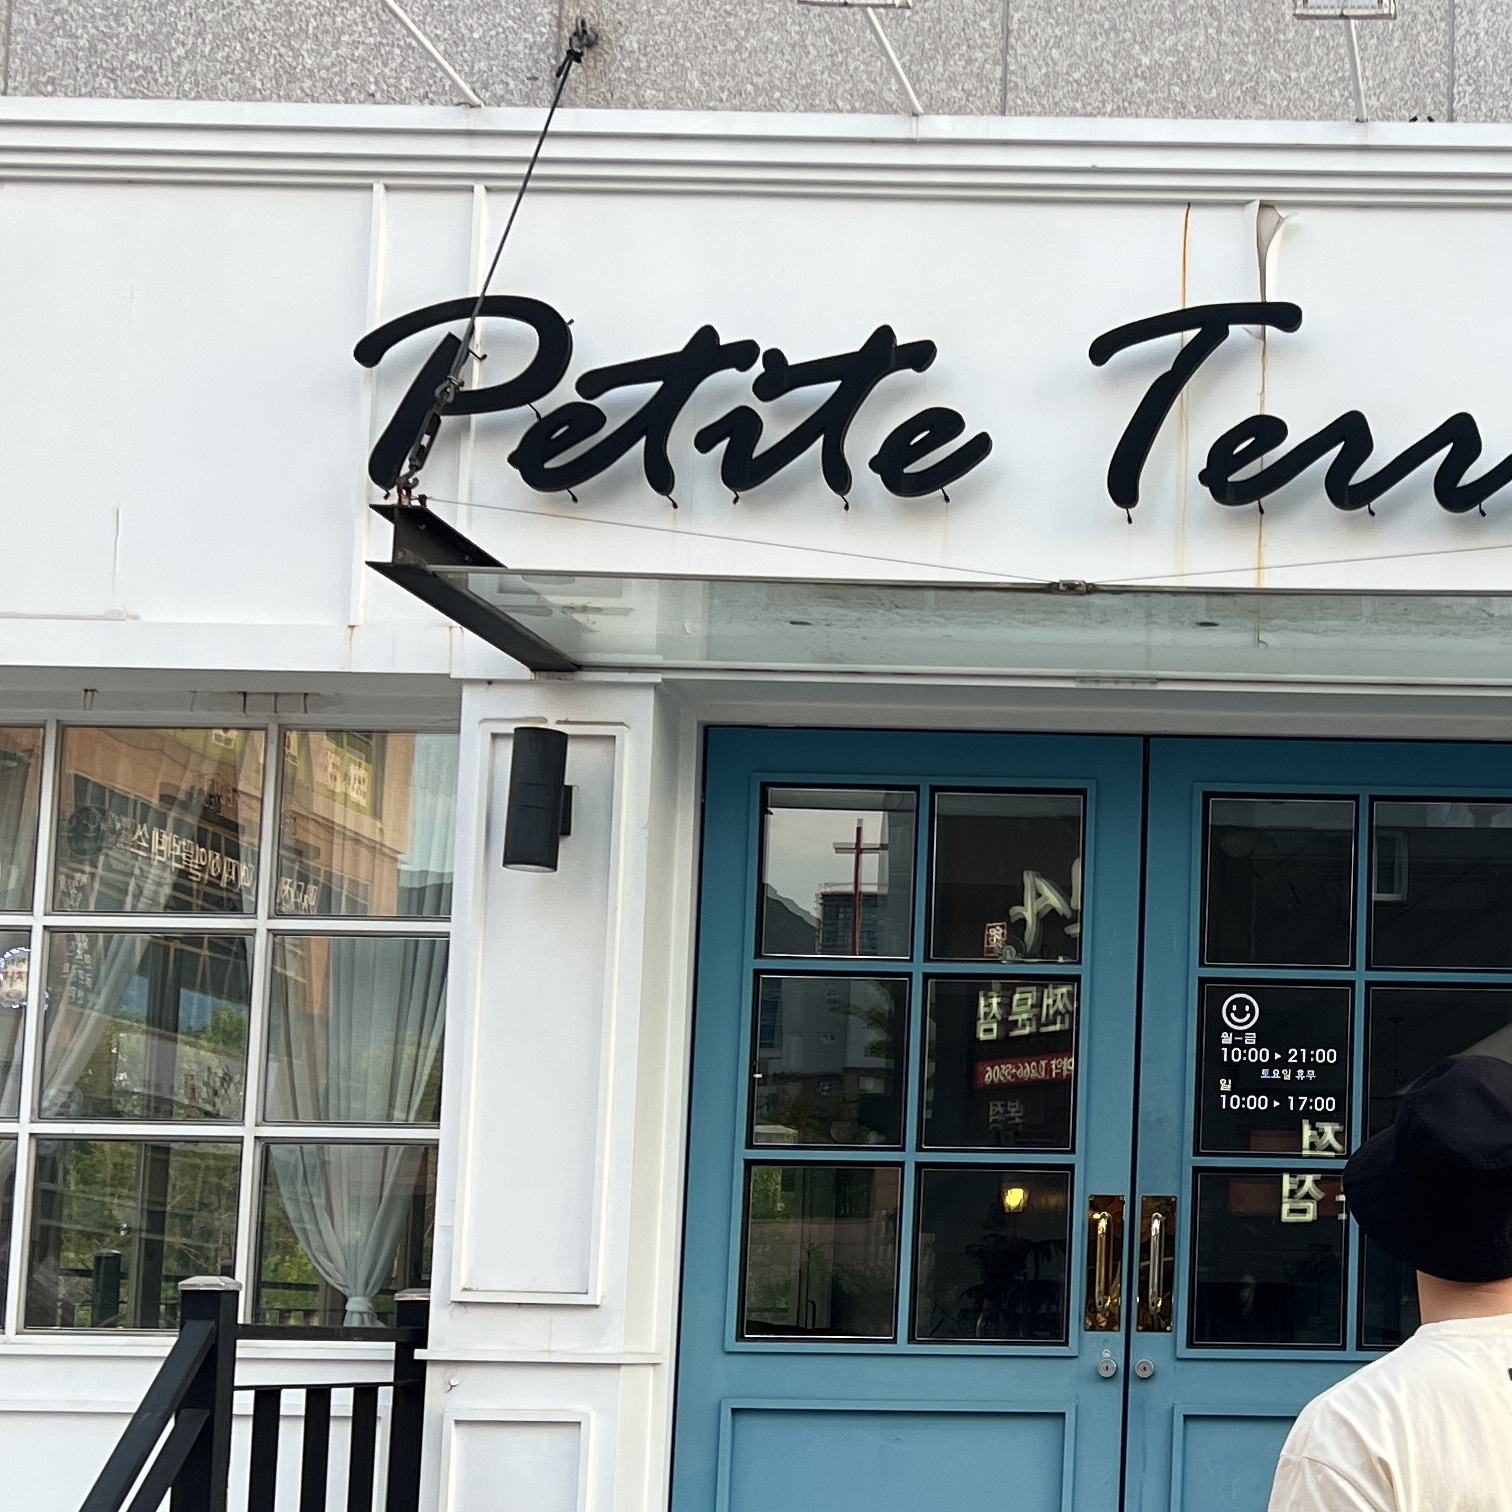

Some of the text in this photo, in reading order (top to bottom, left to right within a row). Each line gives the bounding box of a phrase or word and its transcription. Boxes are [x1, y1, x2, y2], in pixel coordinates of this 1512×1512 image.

[353, 294, 993, 497] Petite
[1221, 1047, 1337, 1063] 10:00 21:00
[1219, 1078, 1232, 1091] 일
[1220, 1094, 1336, 1111] 10:00 17:00
